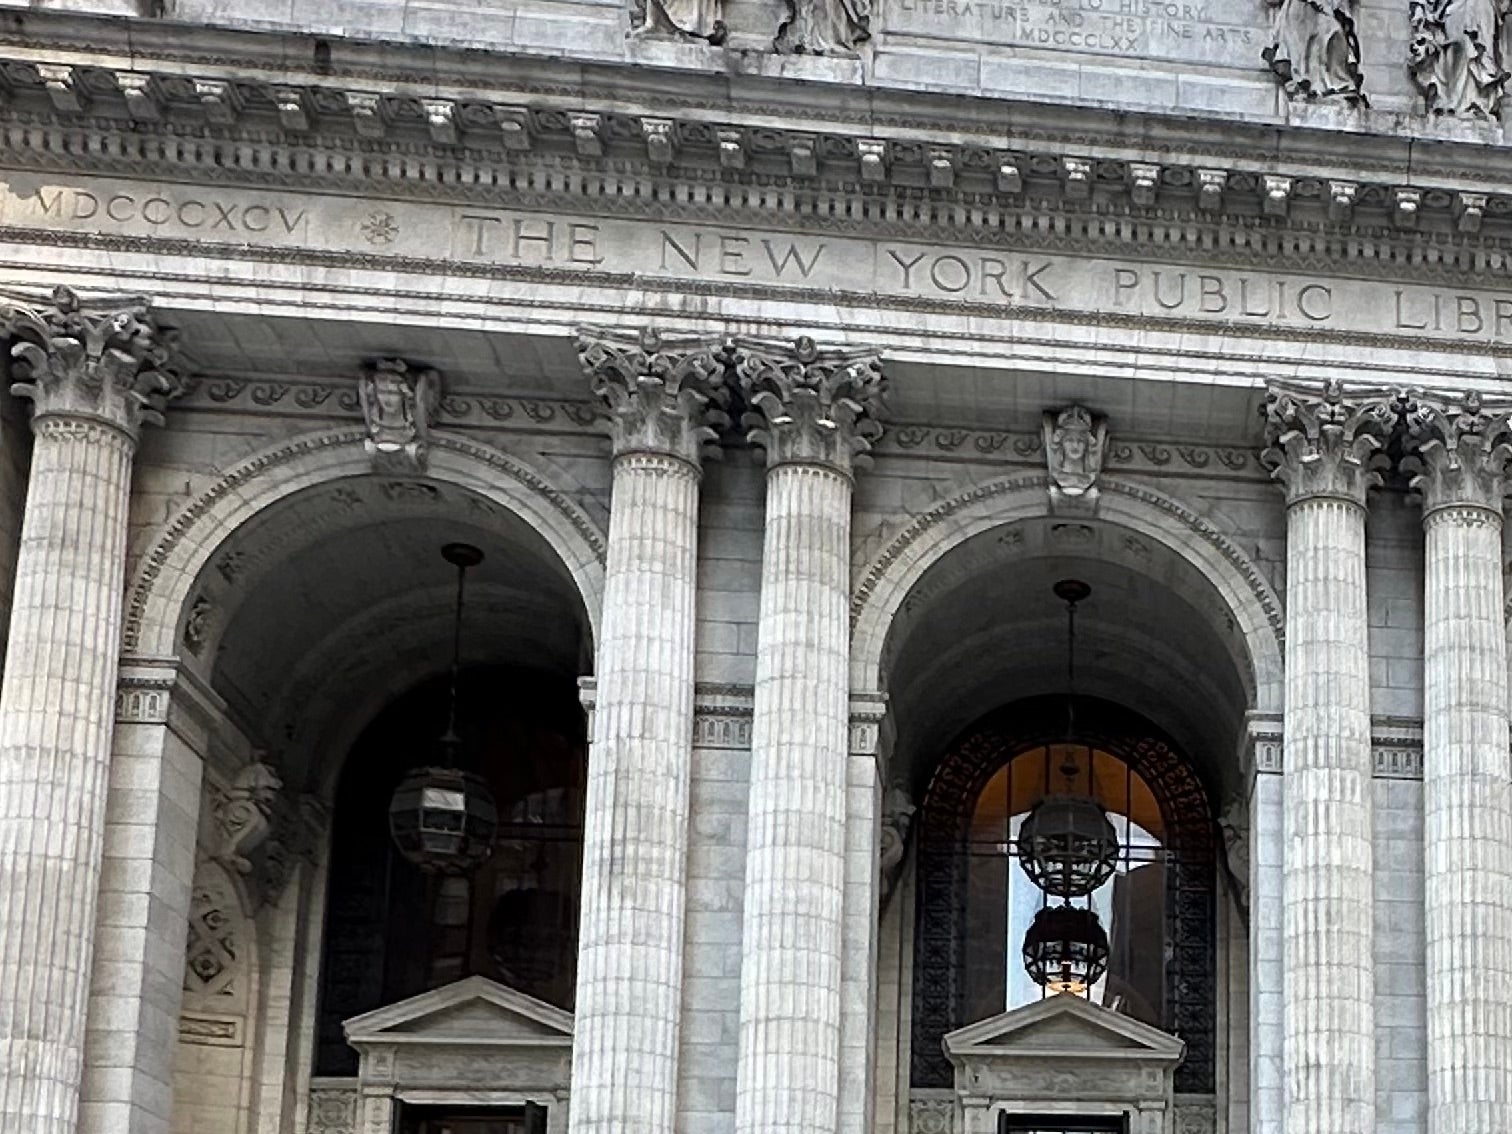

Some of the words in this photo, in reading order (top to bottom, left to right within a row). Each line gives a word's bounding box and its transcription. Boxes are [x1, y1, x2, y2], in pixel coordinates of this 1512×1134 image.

[902, 0, 1030, 22] LITERATURE
[1046, 10, 1084, 28] AND
[1100, 15, 1137, 33] THE
[1150, 19, 1193, 39] FINE
[1203, 27, 1251, 45] ARTS
[35, 186, 306, 234] MDCCCXCV
[461, 214, 605, 265] THE
[660, 230, 827, 279] NEW
[887, 249, 1059, 303] YORK
[1112, 267, 1333, 322] PUBLIC
